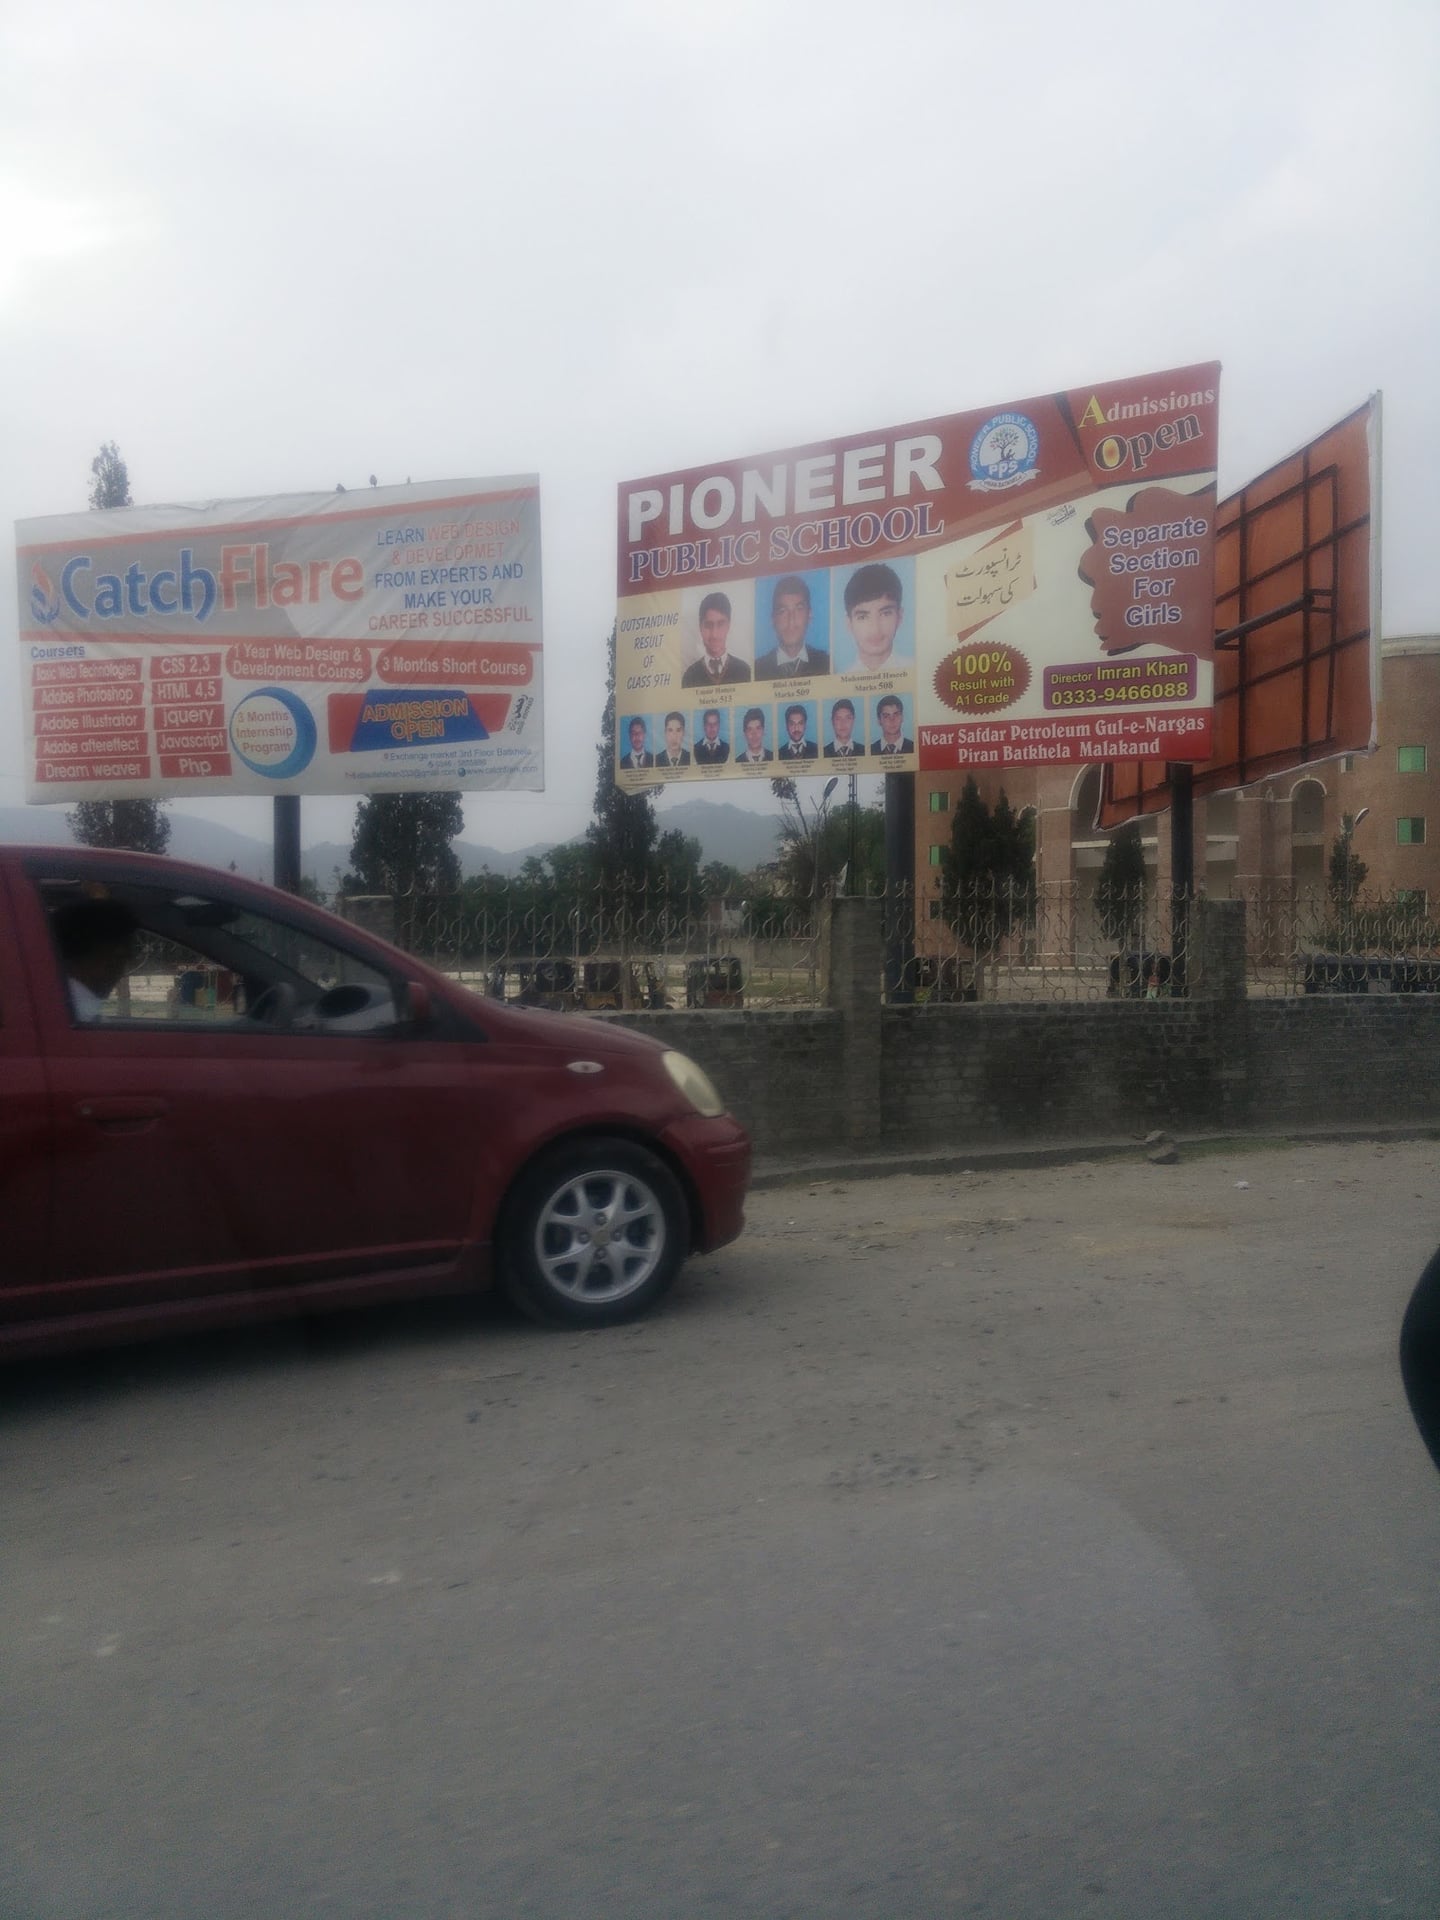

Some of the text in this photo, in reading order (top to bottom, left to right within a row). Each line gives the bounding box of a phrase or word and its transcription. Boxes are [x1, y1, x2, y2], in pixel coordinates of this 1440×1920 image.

[1078, 391, 1216, 428] Admissions
[1094, 413, 1203, 472] Open
[628, 434, 945, 543] PIONEER
[377, 519, 520, 546] LEARN WEB DESIGN
[629, 502, 945, 582] PUBLIC SCHOOL
[1103, 516, 1208, 548] Separate
[392, 542, 505, 565] & DEVELOPMET
[955, 547, 1022, 578] ٹرانسپورٹ
[1110, 547, 1199, 574] Section
[375, 562, 524, 589] FROM EXPERTS AND
[956, 576, 1020, 607] کی سہولت
[1133, 576, 1174, 599] For
[404, 588, 493, 609] MAKE YOUR
[368, 606, 533, 631] CAREER SUCCESSFUL
[620, 613, 679, 632] OUTSTANDING
[1125, 603, 1182, 627] Girls
[31, 645, 85, 658] Coursers
[634, 634, 664, 650] RESULT
[234, 644, 362, 664] 1 Year Web Design &
[643, 655, 654, 668] OF
[952, 651, 1012, 676] 100%
[160, 656, 210, 674] CSS 2,3
[233, 660, 364, 679] Development Course
[382, 657, 527, 676] 3 Months Short Course
[1051, 661, 1188, 684] Director Imran Khan
[157, 681, 216, 699] HTML 4,5
[627, 673, 671, 690] CLASS 9TH
[950, 676, 1015, 692] Result with
[76, 687, 134, 703] Photoshop
[955, 692, 1010, 706] A1 Grade
[1051, 681, 1188, 706] 0333-9466088
[163, 708, 214, 727] jquery
[250, 711, 289, 723] Months
[362, 698, 469, 722] ADMISSION
[41, 714, 137, 731] Adobe Illustrator
[236, 726, 294, 739] Internship
[391, 719, 445, 742] OPEN
[921, 716, 1205, 746] Near Safdar Petroleum Gul-e-Nargas
[45, 740, 78, 754] Adobe
[160, 732, 225, 750] Javascript
[242, 743, 291, 755] Program
[958, 738, 1160, 763] Piran Batkhela Malakand
[45, 762, 141, 778] Dream weaver
[179, 758, 212, 775] Php
